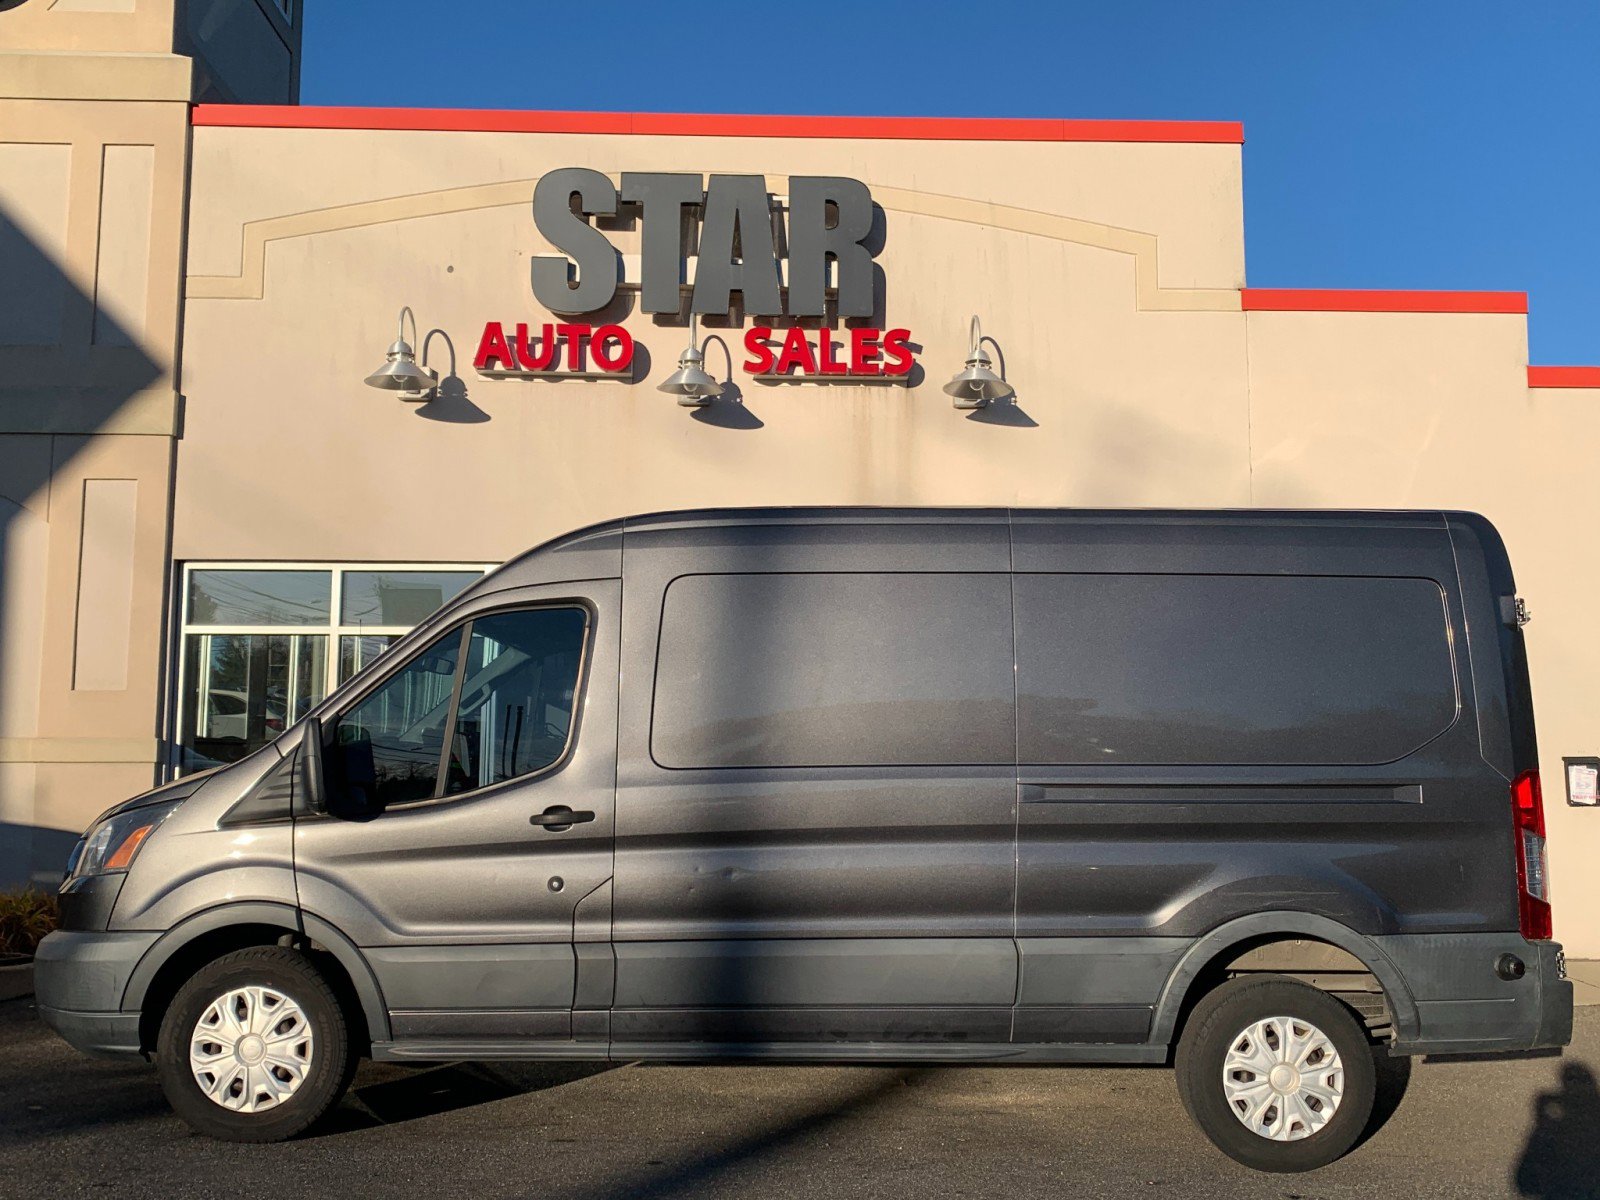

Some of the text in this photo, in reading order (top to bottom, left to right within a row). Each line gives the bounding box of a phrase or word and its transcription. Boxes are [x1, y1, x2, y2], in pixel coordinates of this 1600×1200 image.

[531, 167, 876, 317] STAR
[473, 321, 914, 376] AUTO SALES
